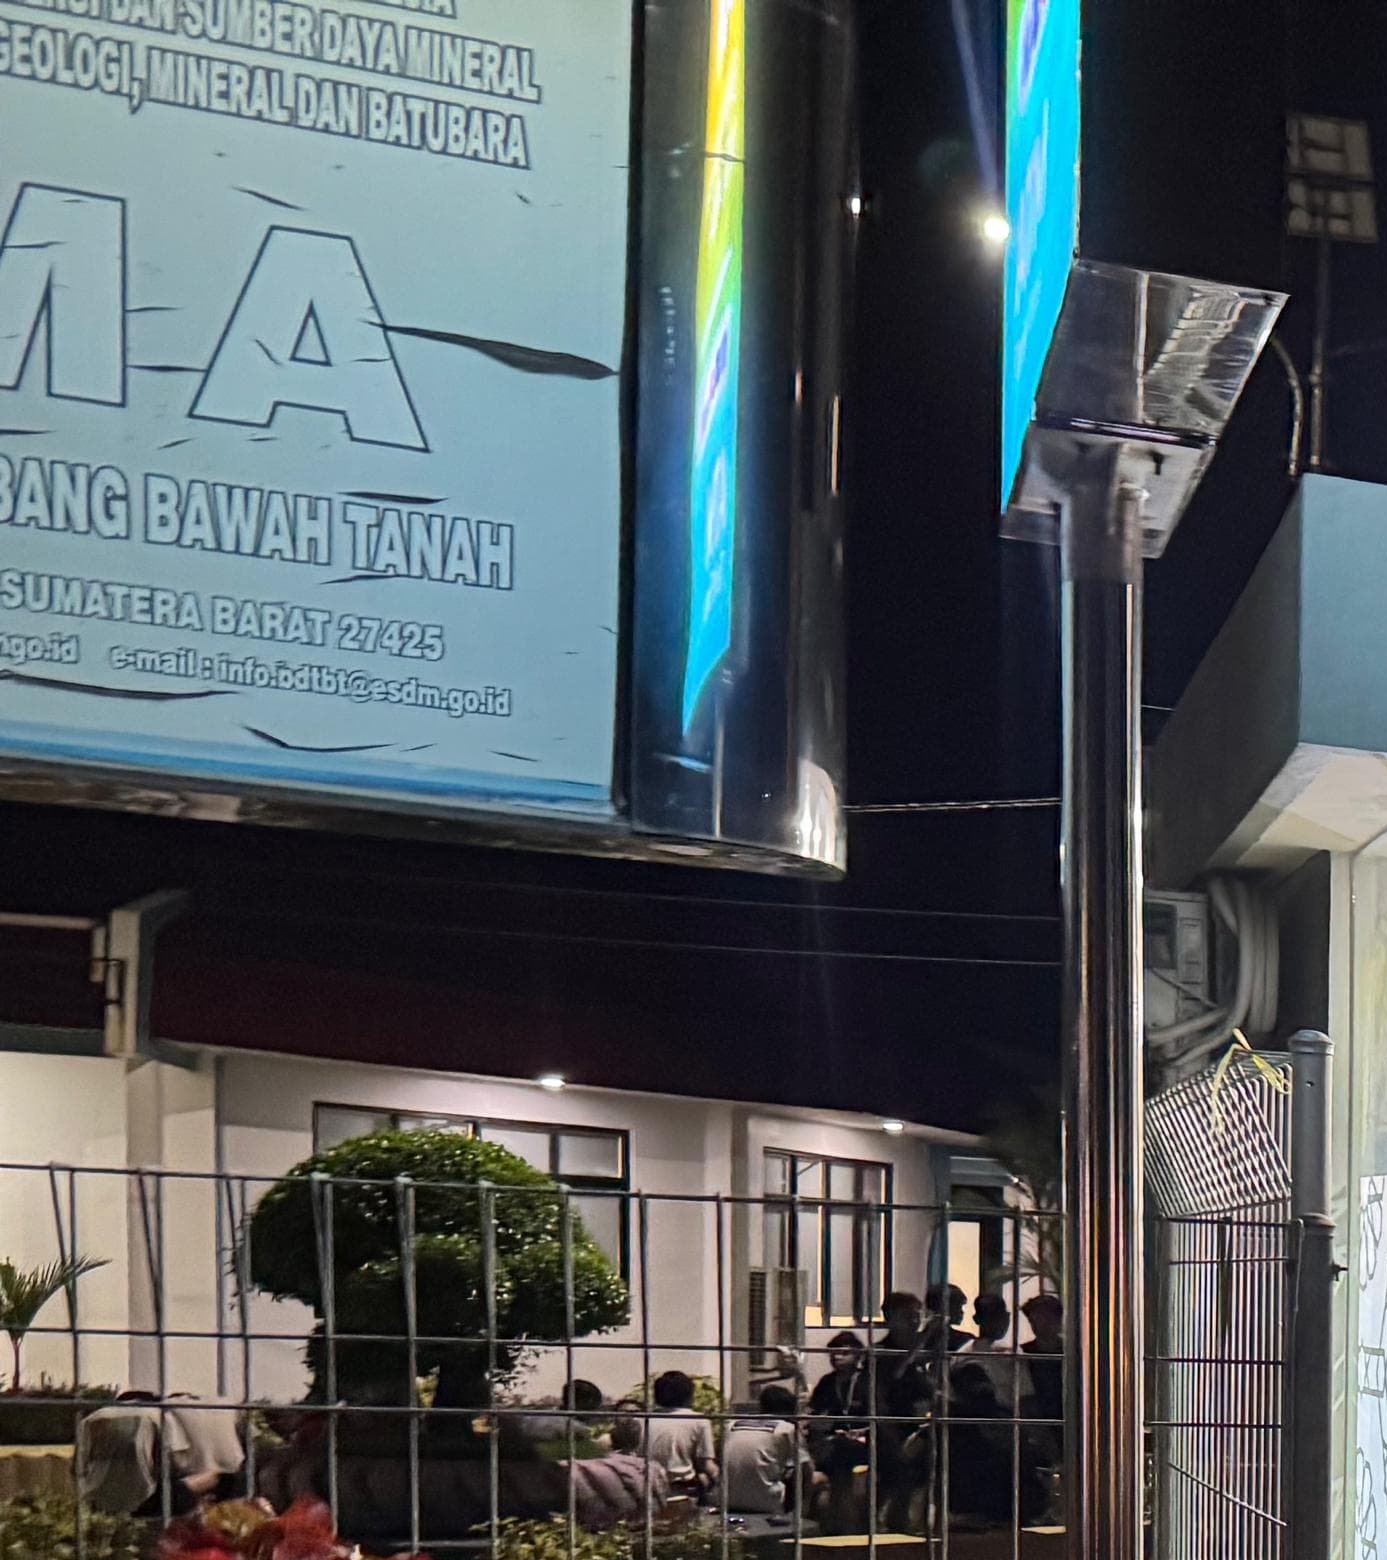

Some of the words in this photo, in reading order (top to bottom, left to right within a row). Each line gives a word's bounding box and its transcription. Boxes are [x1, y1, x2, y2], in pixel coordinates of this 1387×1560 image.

[179, 0, 317, 60] SUMBER
[320, 9, 401, 76] DAYA
[404, 25, 542, 104] MINERAL
[147, 46, 292, 127] MINERAL
[294, 73, 361, 140] DAN
[365, 86, 532, 170] BATUBARA
[144, 473, 332, 566] BAWAH
[342, 501, 514, 591] TANAH
[0, 568, 204, 632] SUMATERA
[211, 595, 331, 646] BARAT
[337, 614, 445, 662] 27425
[109, 645, 197, 678] e-mail
